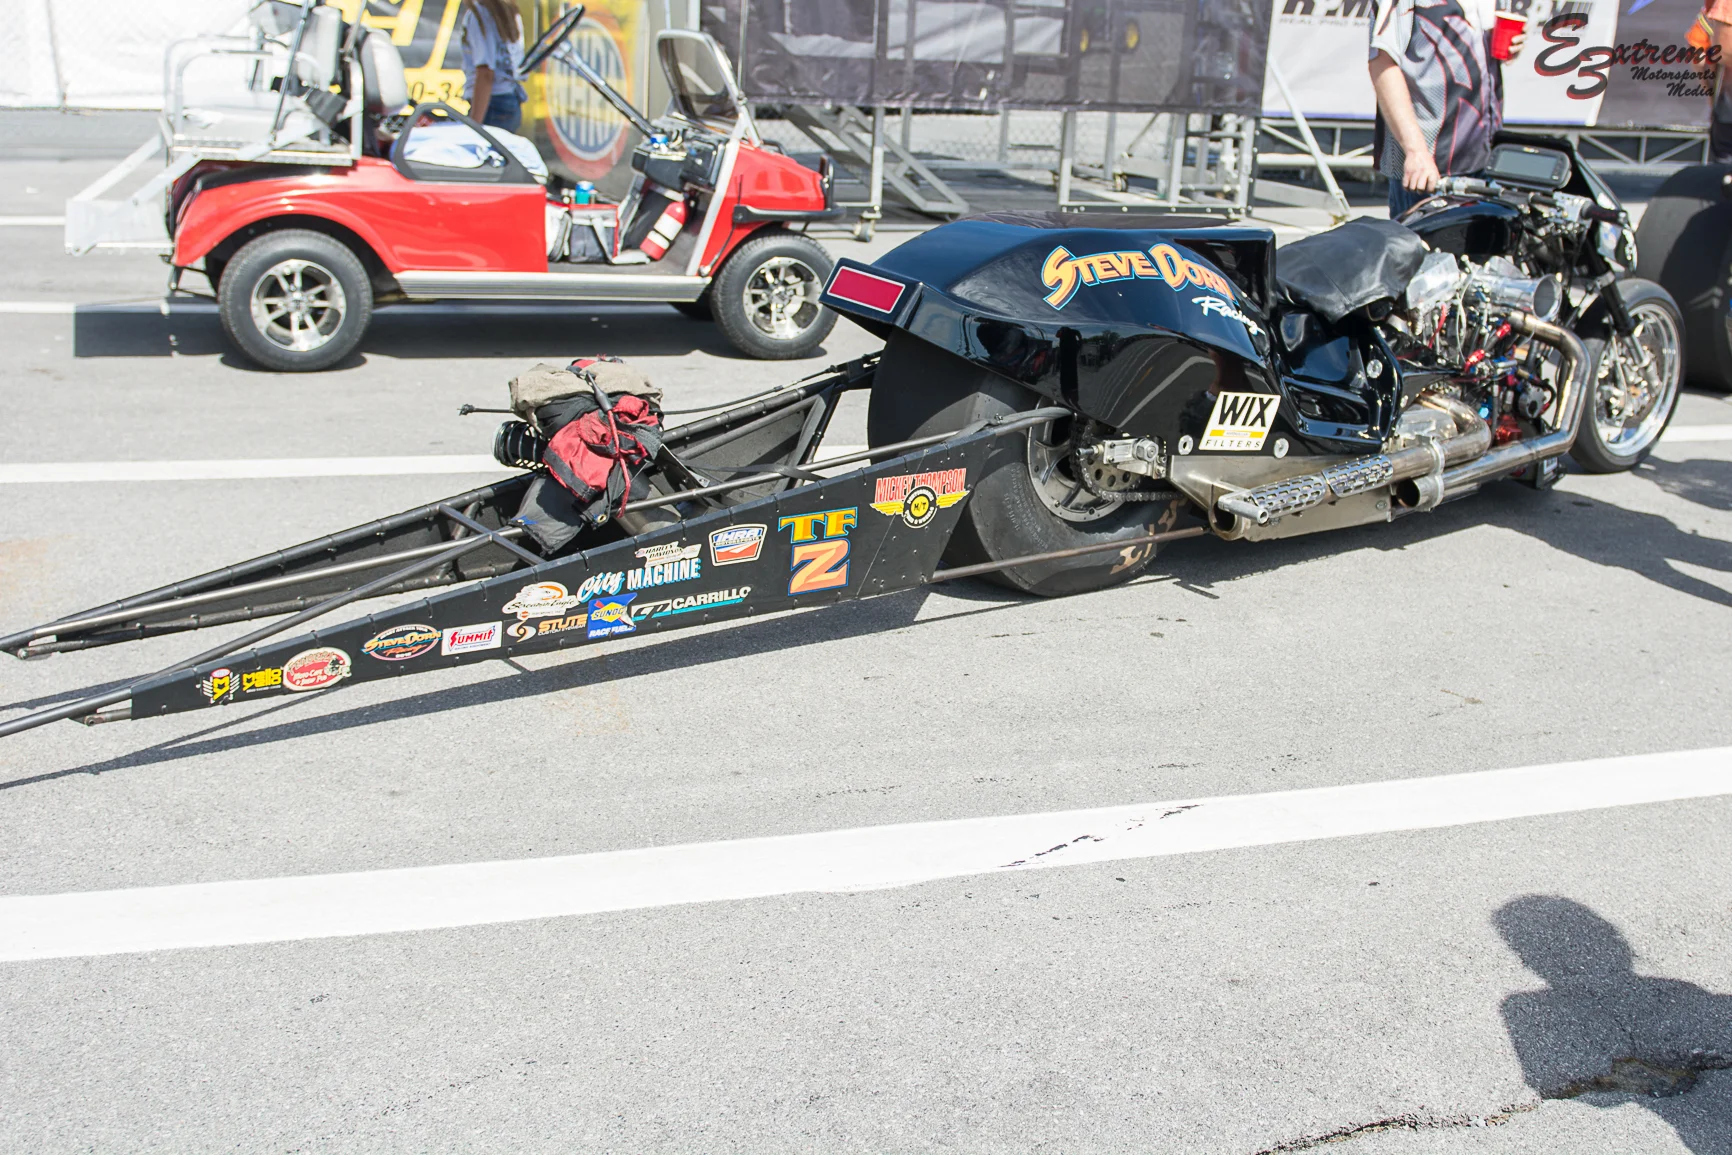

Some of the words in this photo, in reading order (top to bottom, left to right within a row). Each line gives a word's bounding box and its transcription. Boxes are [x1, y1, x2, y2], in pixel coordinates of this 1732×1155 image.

[1192, 296, 1266, 335] Racing
[1218, 395, 1274, 427] WIX
[1205, 439, 1261, 448] FILTERS
[874, 474, 915, 503] MICKEY
[914, 468, 967, 495] THOMPSON
[714, 528, 761, 543] IHRA
[778, 506, 858, 544] TF
[576, 570, 626, 603] City
[627, 558, 702, 591] MACHINE
[672, 586, 752, 609] CARRILLO
[537, 628, 560, 636] CUSTOM
[538, 614, 588, 632] STUTE
[589, 628, 610, 638] RACE
